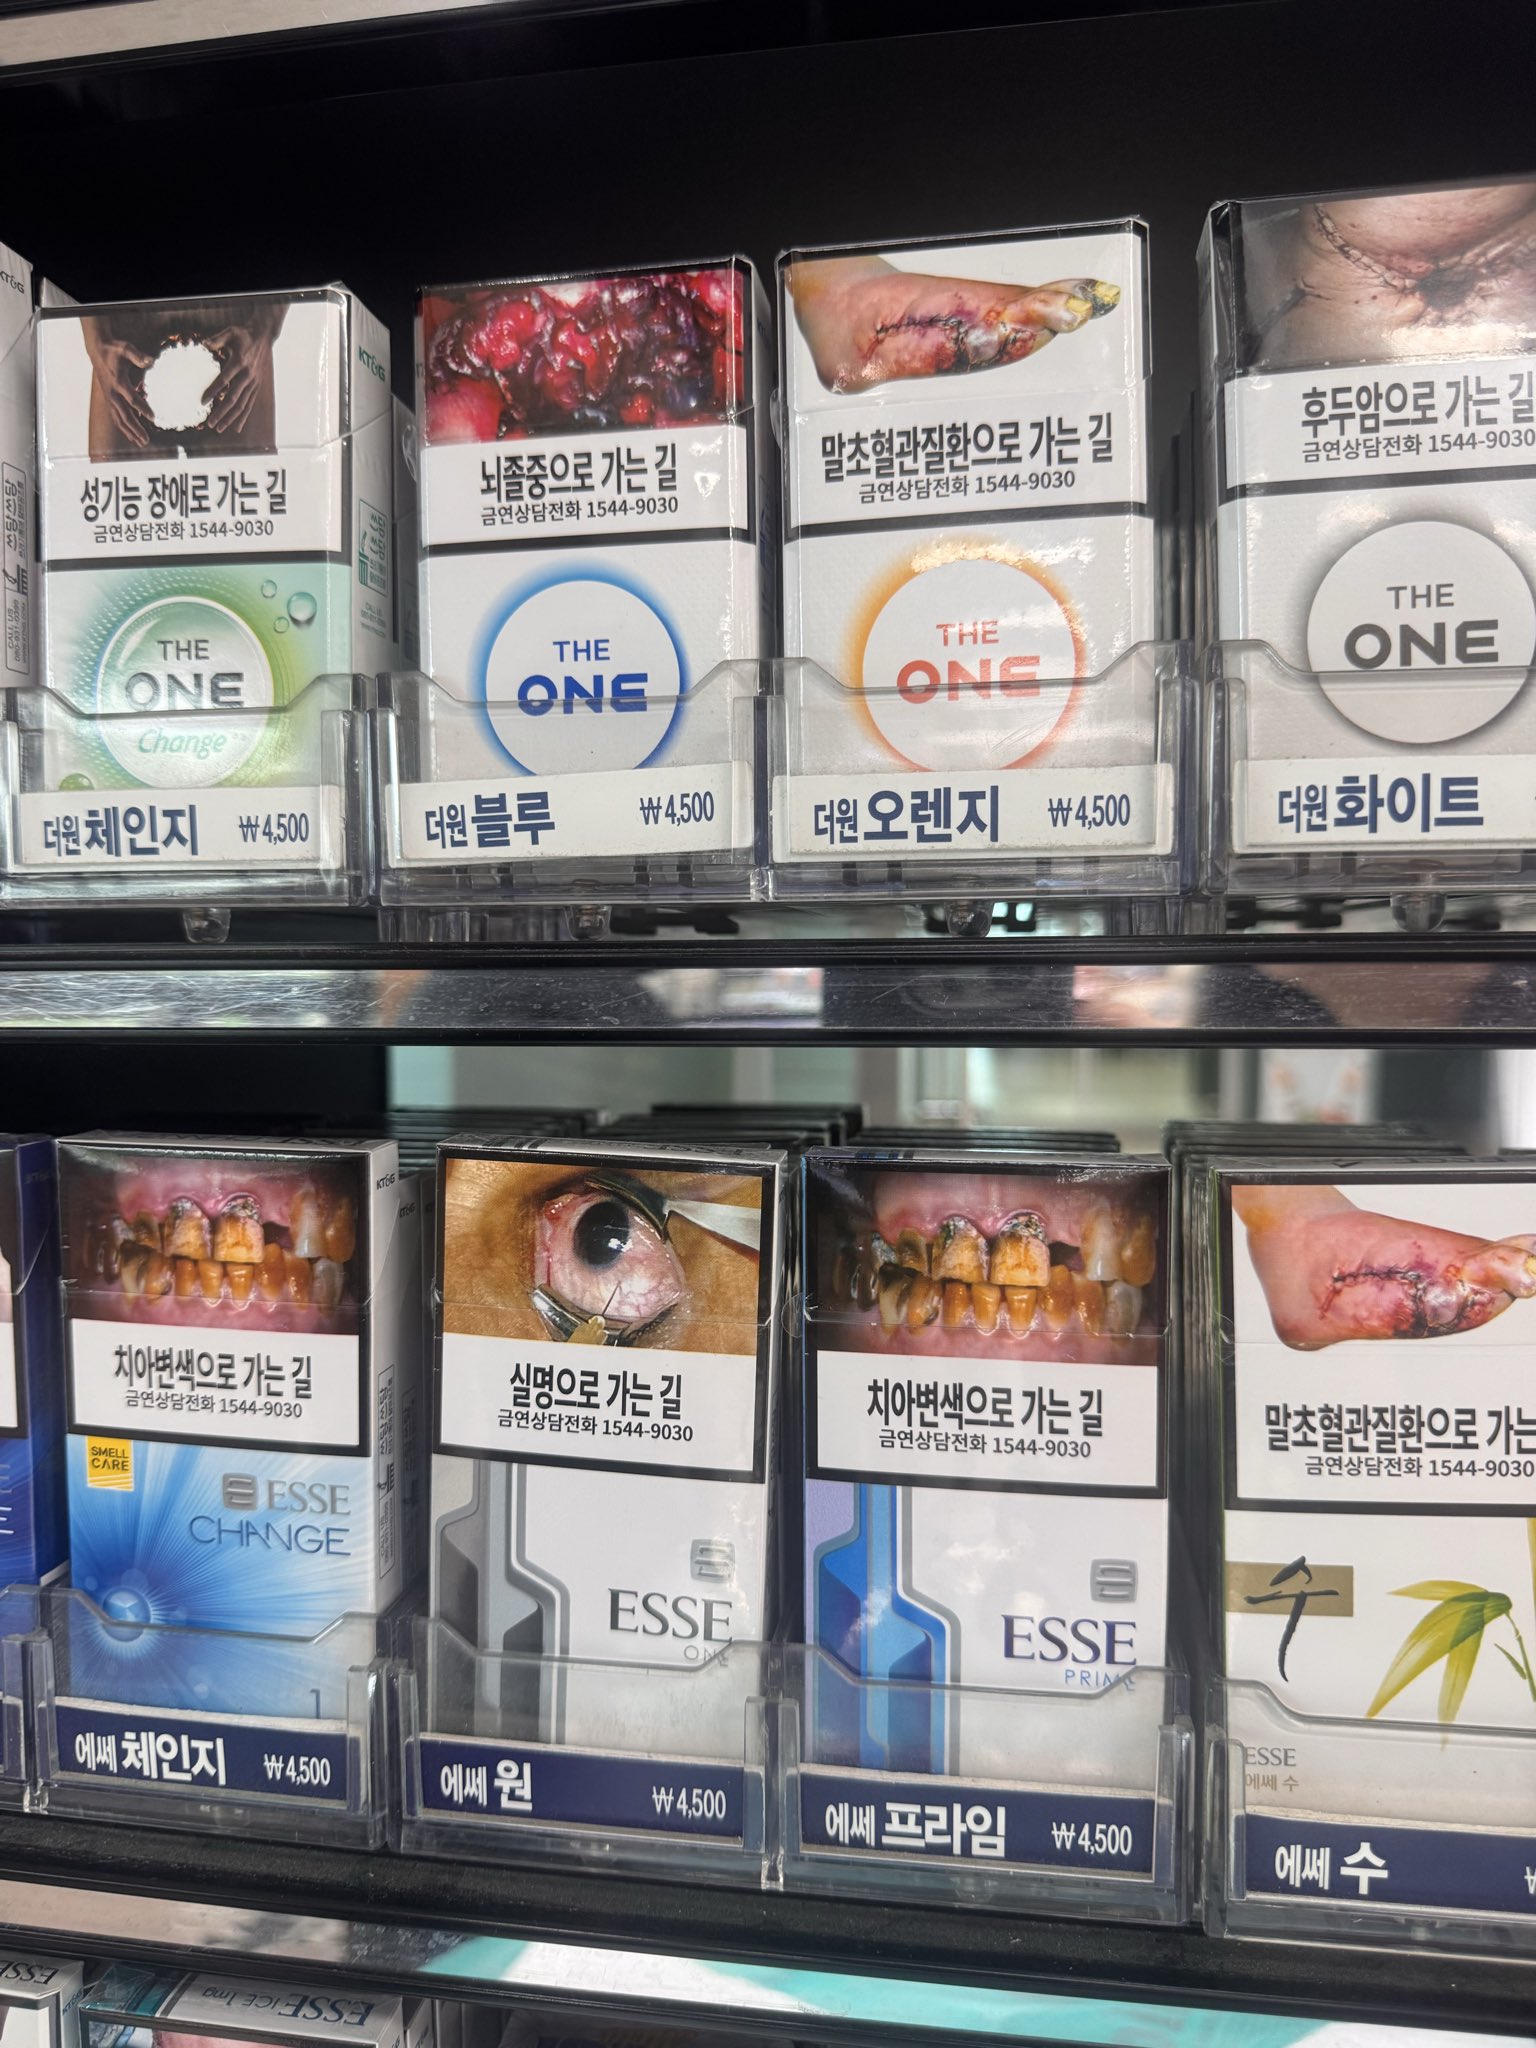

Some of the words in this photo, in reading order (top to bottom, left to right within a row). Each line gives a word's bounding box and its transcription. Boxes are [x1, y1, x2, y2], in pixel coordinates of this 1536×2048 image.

[358, 345, 386, 382] KT&G
[1301, 380, 1438, 439] 후두암으로
[1445, 375, 1500, 428] 가는
[1508, 370, 1534, 424] 길
[821, 421, 1023, 484] 말초혈관질환으로
[1029, 416, 1081, 466] 가는
[1088, 412, 1113, 463] 길
[1302, 434, 1422, 463] 금연상담전화
[1428, 428, 1536, 453] 1544-9030
[480, 452, 595, 503] 뇌졸중으로
[601, 447, 648, 495] 가는
[654, 443, 678, 492] 길
[859, 475, 970, 504] 금연상담전화
[975, 470, 1076, 495] 1544-9030
[80, 476, 142, 522] 성기능
[147, 473, 211, 519] 장애로
[217, 471, 260, 517] 가는
[267, 469, 287, 515] 길
[481, 501, 582, 526] 금연상담전화
[587, 496, 679, 519] 1544-9030
[94, 522, 185, 543] 금연상담전화
[190, 520, 274, 539] 1544-9030
[1386, 583, 1454, 610] THE
[157, 639, 210, 661] THE
[553, 639, 610, 663] THE
[936, 620, 999, 647] THE
[1344, 619, 1499, 670] ONE
[125, 672, 245, 711] ONE
[518, 673, 648, 717] ONE
[896, 655, 1041, 704] ONE
[137, 728, 227, 758] Change
[639, 791, 715, 827] ₩4,500
[1048, 793, 1130, 831] ₩4,500
[239, 813, 310, 846] ₩4,500
[376, 1173, 396, 1190] KT&G
[114, 1344, 236, 1392] 치아변색으로
[243, 1353, 284, 1397] 가는
[291, 1355, 313, 1399] 길
[125, 1389, 215, 1413] 금연상담전화
[219, 1398, 303, 1418] 1544-9030
[509, 1362, 600, 1410] 실명으로
[606, 1370, 653, 1419] 가는
[659, 1374, 682, 1420] 길
[867, 1378, 1015, 1430] 치아변색으로
[1021, 1386, 1072, 1435] 가는
[1078, 1389, 1103, 1437] 길
[498, 1408, 598, 1436] 금연상담전화
[602, 1419, 693, 1442] 1544-9030
[1265, 1403, 1479, 1454] 말초혈관질환으로
[1486, 1405, 1536, 1455] 가는
[91, 1446, 129, 1459] SMELL
[879, 1429, 987, 1454] 금연상담전화
[992, 1437, 1091, 1458] 1544-9030
[91, 1457, 130, 1472] CARE
[1305, 1456, 1423, 1478] 금연상담전화
[1428, 1459, 1535, 1477] 1544-9030
[267, 1479, 351, 1516] ESSE
[189, 1515, 352, 1556] CHANGE
[608, 1587, 733, 1643] ESSE
[1001, 1614, 1137, 1666] ESSE
[74, 1732, 117, 1774] 에쎄
[121, 1731, 226, 1786] 체인지
[263, 1752, 332, 1786] ₩4,500
[1245, 1746, 1297, 1767] ESSE
[440, 1764, 487, 1806] 에쎄
[494, 1759, 532, 1812] 원
[652, 1785, 727, 1819] ₩4,500
[1282, 1774, 1299, 1792] 수
[825, 1802, 875, 1847] 에쎄
[881, 1802, 1006, 1857] 프라임
[1051, 1822, 1133, 1856] ₩4,500
[1275, 1844, 1330, 1890] 에쎄
[1340, 1841, 1388, 1895] 수
[202, 1986, 238, 2006] 1mg
[241, 1993, 280, 2010] ICE
[278, 1993, 376, 2026] ESSE
